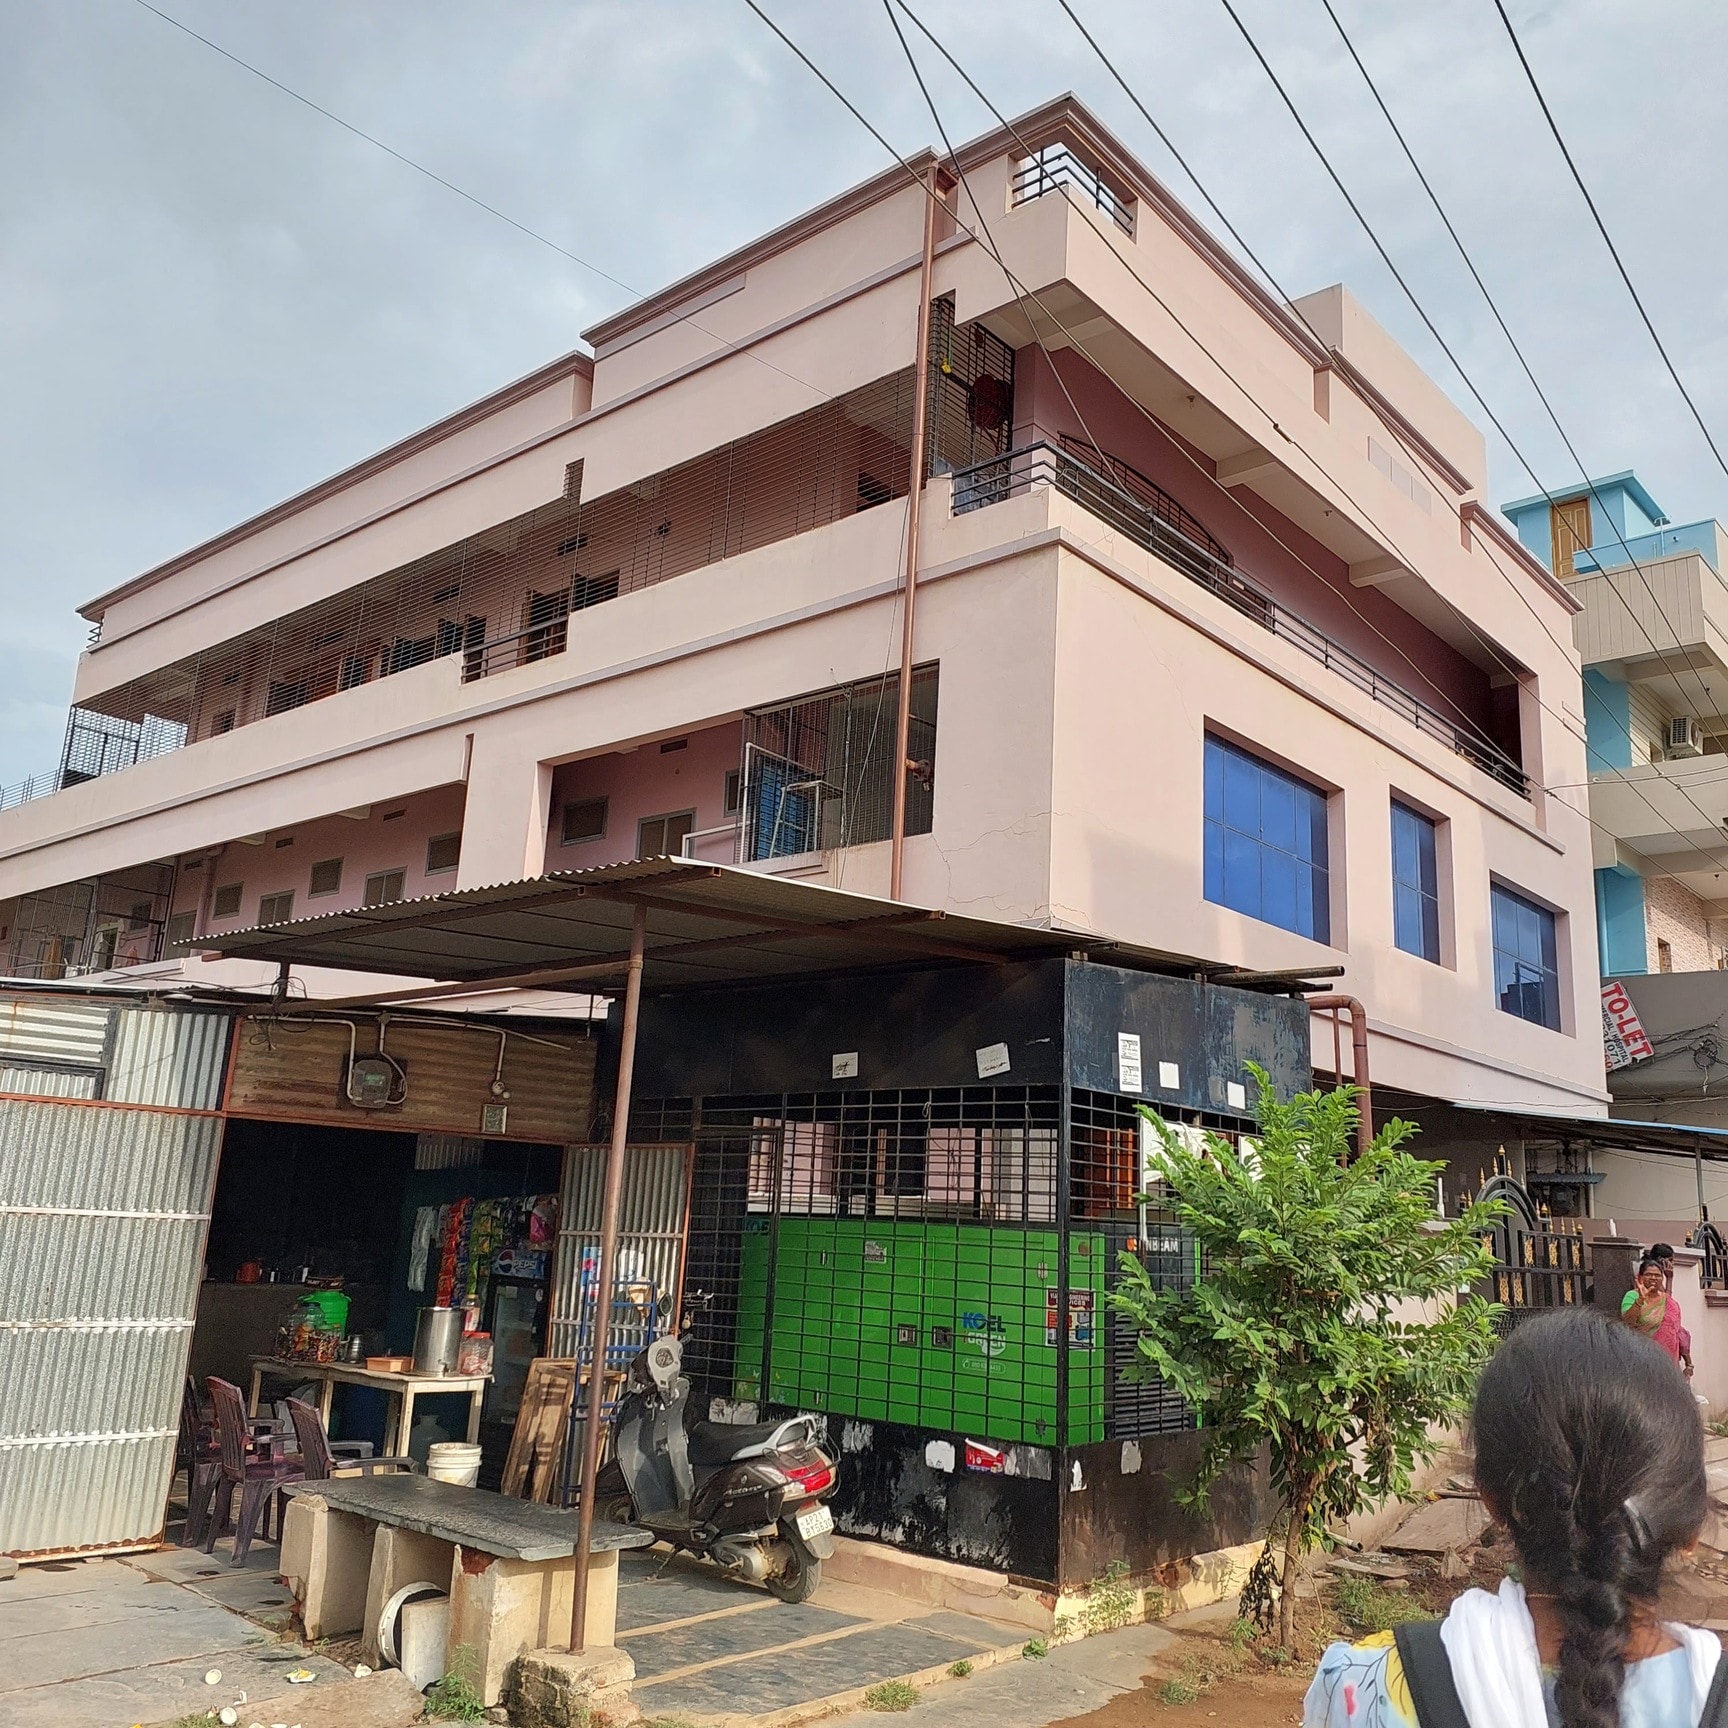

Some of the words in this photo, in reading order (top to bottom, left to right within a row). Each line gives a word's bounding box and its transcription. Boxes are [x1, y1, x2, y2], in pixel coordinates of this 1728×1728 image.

[1601, 983, 1652, 1056] TO-LET
[1601, 1003, 1615, 1031] MERCIAL
[1611, 1033, 1630, 1063] HOSPITAL
[1602, 1024, 1621, 1064] 31071
[512, 1259, 537, 1270] PEPSI
[962, 1311, 1006, 1333] KOEL
[805, 1511, 824, 1526] AP21
